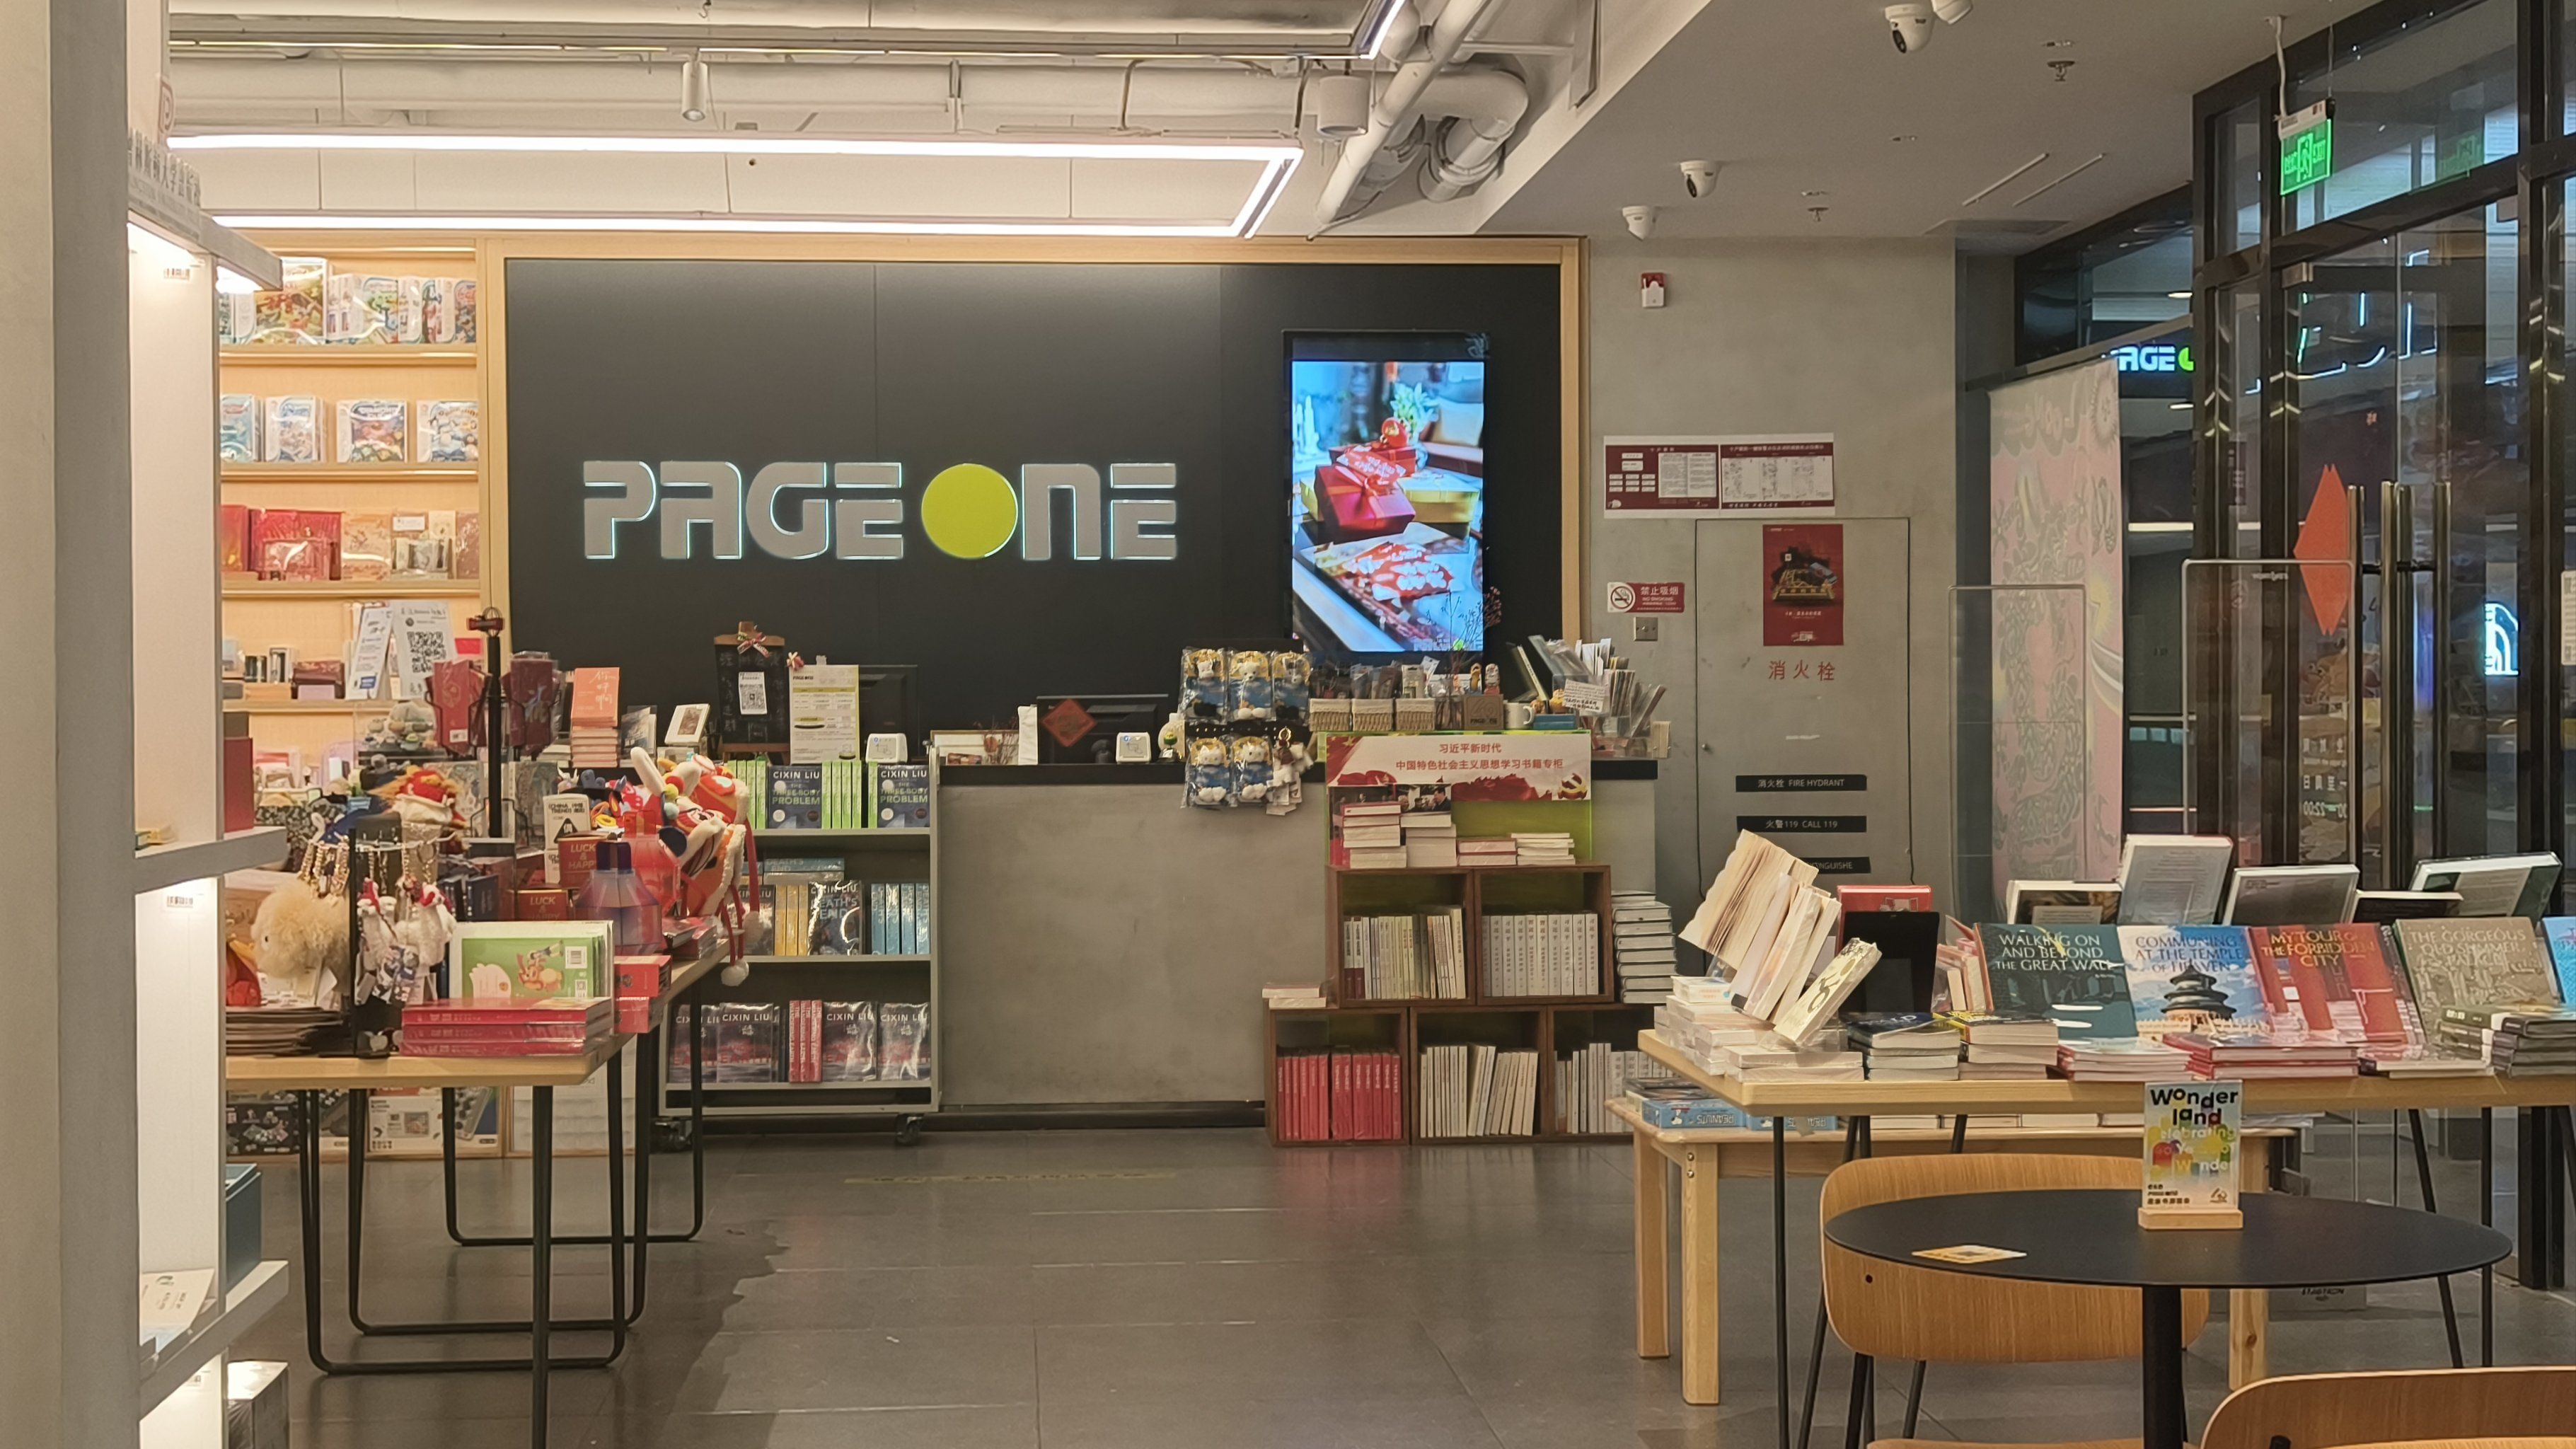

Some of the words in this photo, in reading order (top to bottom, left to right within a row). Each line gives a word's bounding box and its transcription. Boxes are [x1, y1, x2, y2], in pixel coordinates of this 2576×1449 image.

[1640, 586, 1679, 595] 禁止吸烟
[1769, 659, 1835, 681] 消火栓
[1439, 743, 1502, 754] 习近平新时代
[1396, 758, 1564, 770] 中国特色社会主义思想学习书籍专柜
[773, 771, 800, 780] CIXIN
[805, 770, 820, 779] LIU
[881, 770, 908, 778] CIXIN
[1757, 778, 1784, 788] 消火栓
[773, 796, 820, 805] PROBLEM
[880, 795, 928, 804] PROBLEM
[570, 844, 596, 853] LUCK
[568, 860, 596, 869] HAPP
[530, 896, 555, 905] LUCK
[1999, 933, 2071, 947] WALKING
[2074, 935, 2100, 946] ON
[2135, 935, 2237, 948] COMMUNING
[2271, 932, 2292, 944] MY
[2295, 930, 2341, 943] TOUR
[2410, 931, 2436, 943] THE
[2441, 929, 2526, 942] GORGEOUS
[2002, 947, 2035, 958] AND
[2040, 947, 2103, 959] BEYOND
[2135, 948, 2156, 960] AT
[2158, 948, 2189, 960] THE
[2190, 948, 2243, 960] TEMPLE
[2260, 946, 2286, 957] THE
[1995, 960, 2018, 970] THE
[2021, 959, 2067, 971] GREAT
[2299, 954, 2340, 967] CITY
[2152, 962, 2169, 973] OF
[722, 1013, 750, 1022] CIXIN
[2150, 1088, 2239, 1109] Wonder
[1697, 1114, 1735, 1124] PEANUTS
[2173, 1108, 2222, 1126] land
